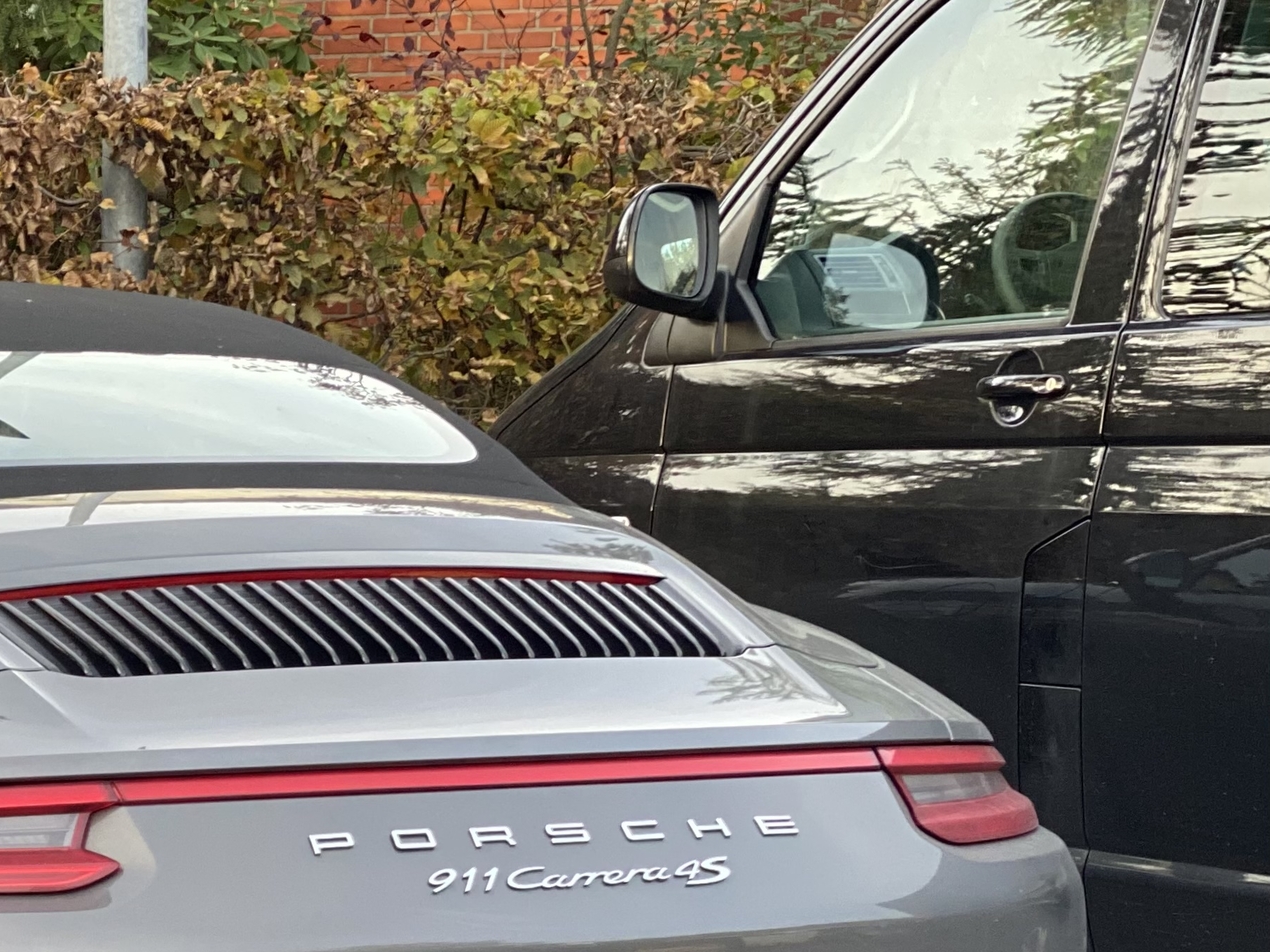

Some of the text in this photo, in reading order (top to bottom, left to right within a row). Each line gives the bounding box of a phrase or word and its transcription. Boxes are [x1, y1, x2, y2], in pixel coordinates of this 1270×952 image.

[308, 814, 799, 855] PORSCHE
[428, 856, 731, 893] 911 Carrera 4S
